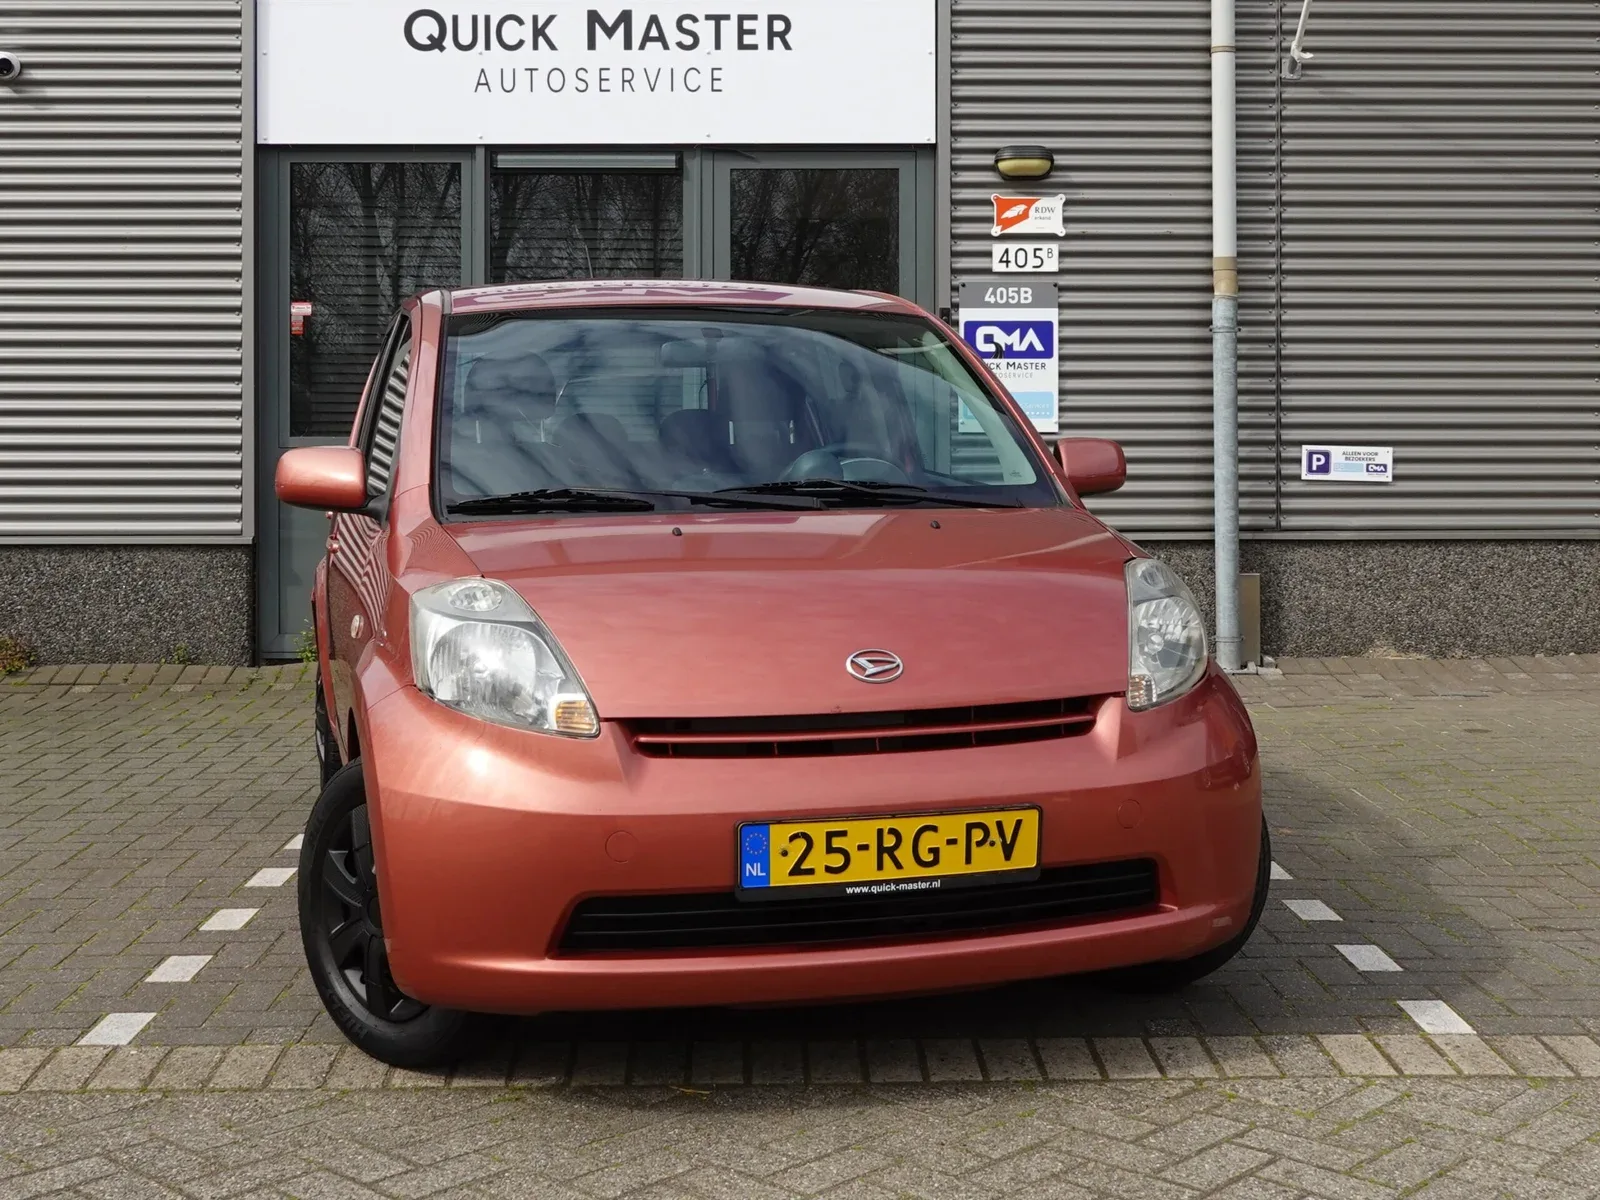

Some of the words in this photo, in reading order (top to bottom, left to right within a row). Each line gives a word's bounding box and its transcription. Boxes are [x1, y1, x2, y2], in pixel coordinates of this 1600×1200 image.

[403, 8, 559, 53] QUICK
[586, 9, 793, 51] MASTER
[474, 67, 723, 93] AUTOSERVICE
[1034, 206, 1056, 214] RDW
[983, 286, 1033, 304] 405B
[1006, 361, 1047, 371] MASTER
[1312, 454, 1325, 470] P
[787, 818, 1023, 877] 25-RG-PV
[745, 862, 766, 877] NL
[845, 879, 941, 895] www.quick-master.nl
